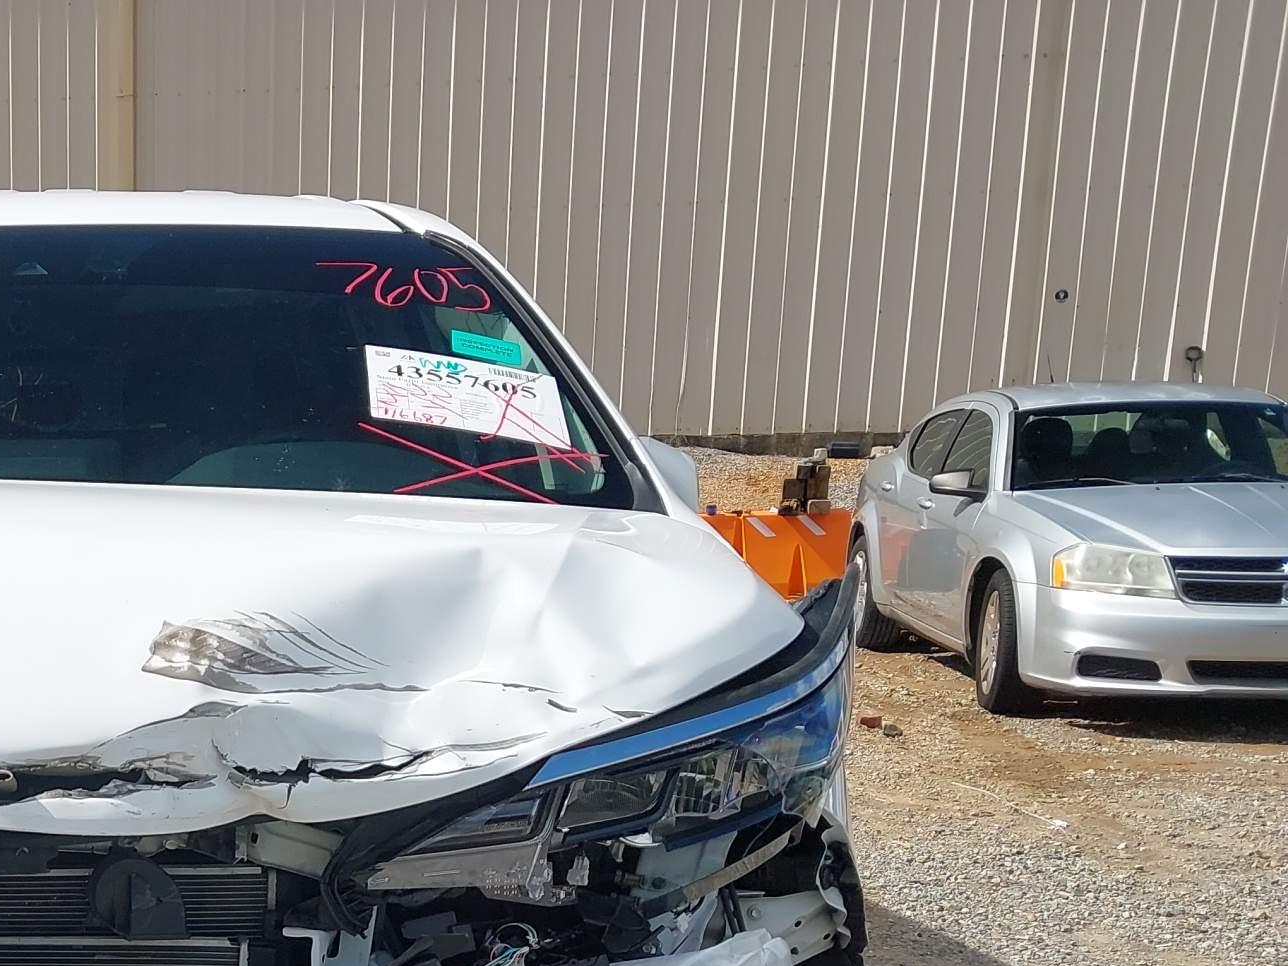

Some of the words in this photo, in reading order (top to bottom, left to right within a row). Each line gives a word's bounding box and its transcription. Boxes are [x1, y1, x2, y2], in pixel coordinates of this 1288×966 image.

[315, 261, 491, 313] 7605
[456, 337, 514, 353] INSPECTION
[462, 343, 513, 358] COMPLETE
[387, 364, 537, 399] 43557605
